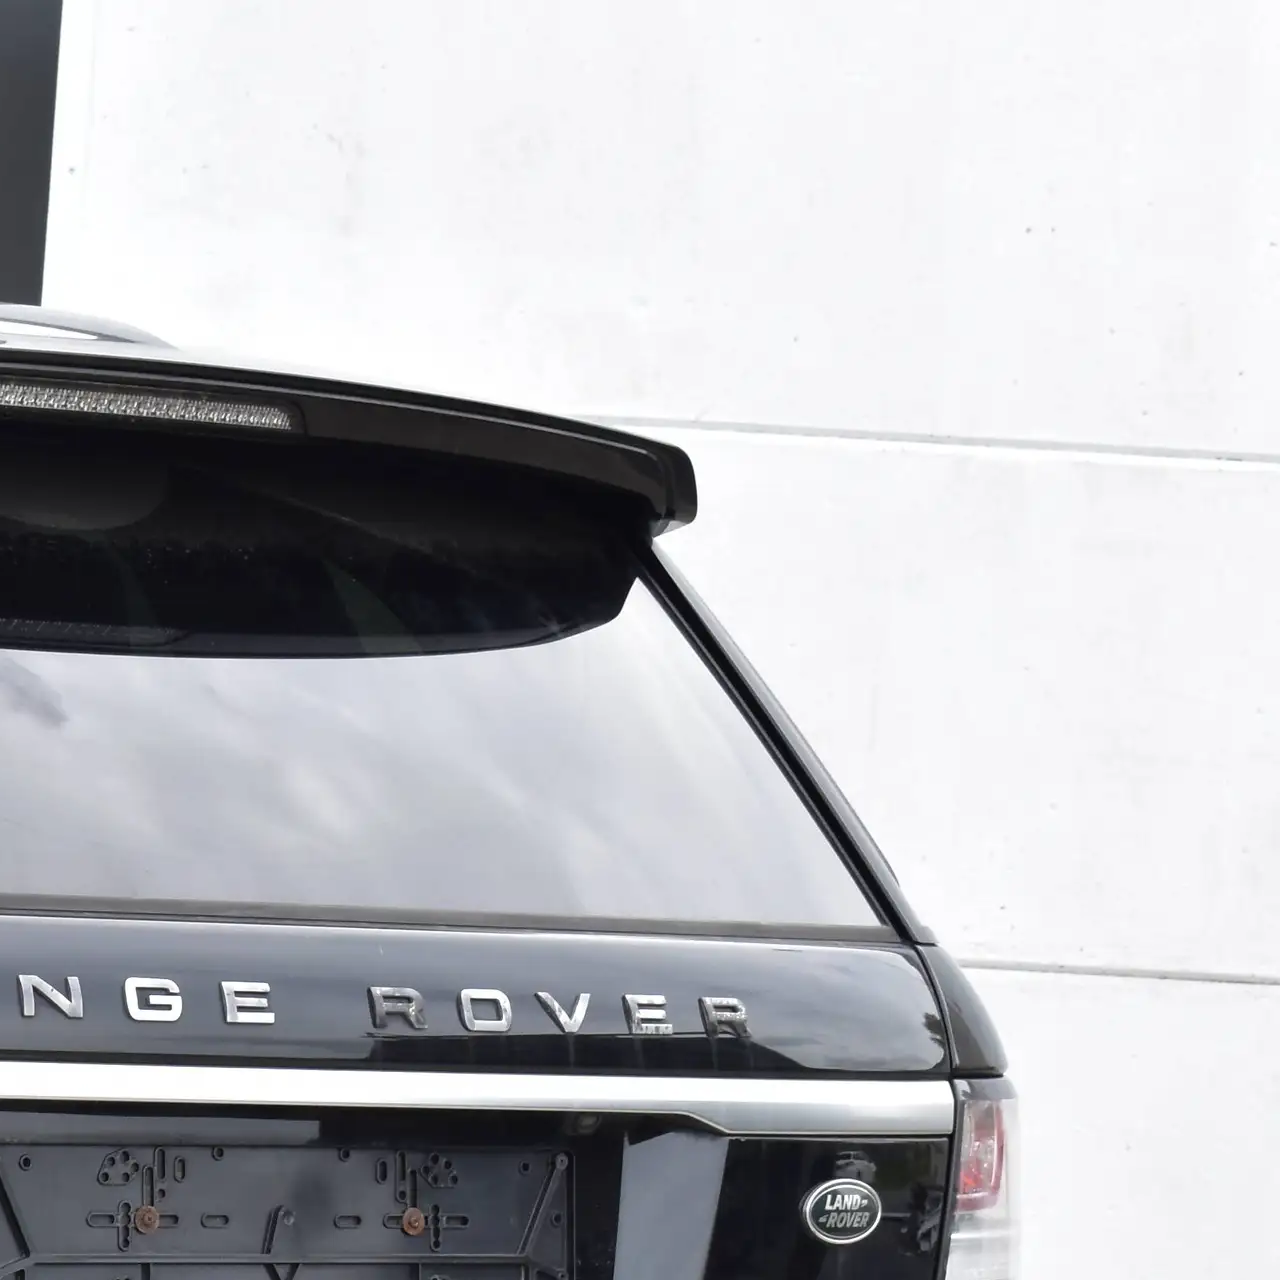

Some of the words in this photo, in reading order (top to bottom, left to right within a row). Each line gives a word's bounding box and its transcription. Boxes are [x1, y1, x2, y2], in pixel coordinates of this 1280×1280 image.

[366, 986, 752, 1038] ROVER
[824, 1194, 862, 1211] LAND
[826, 1211, 870, 1228] ROVER
